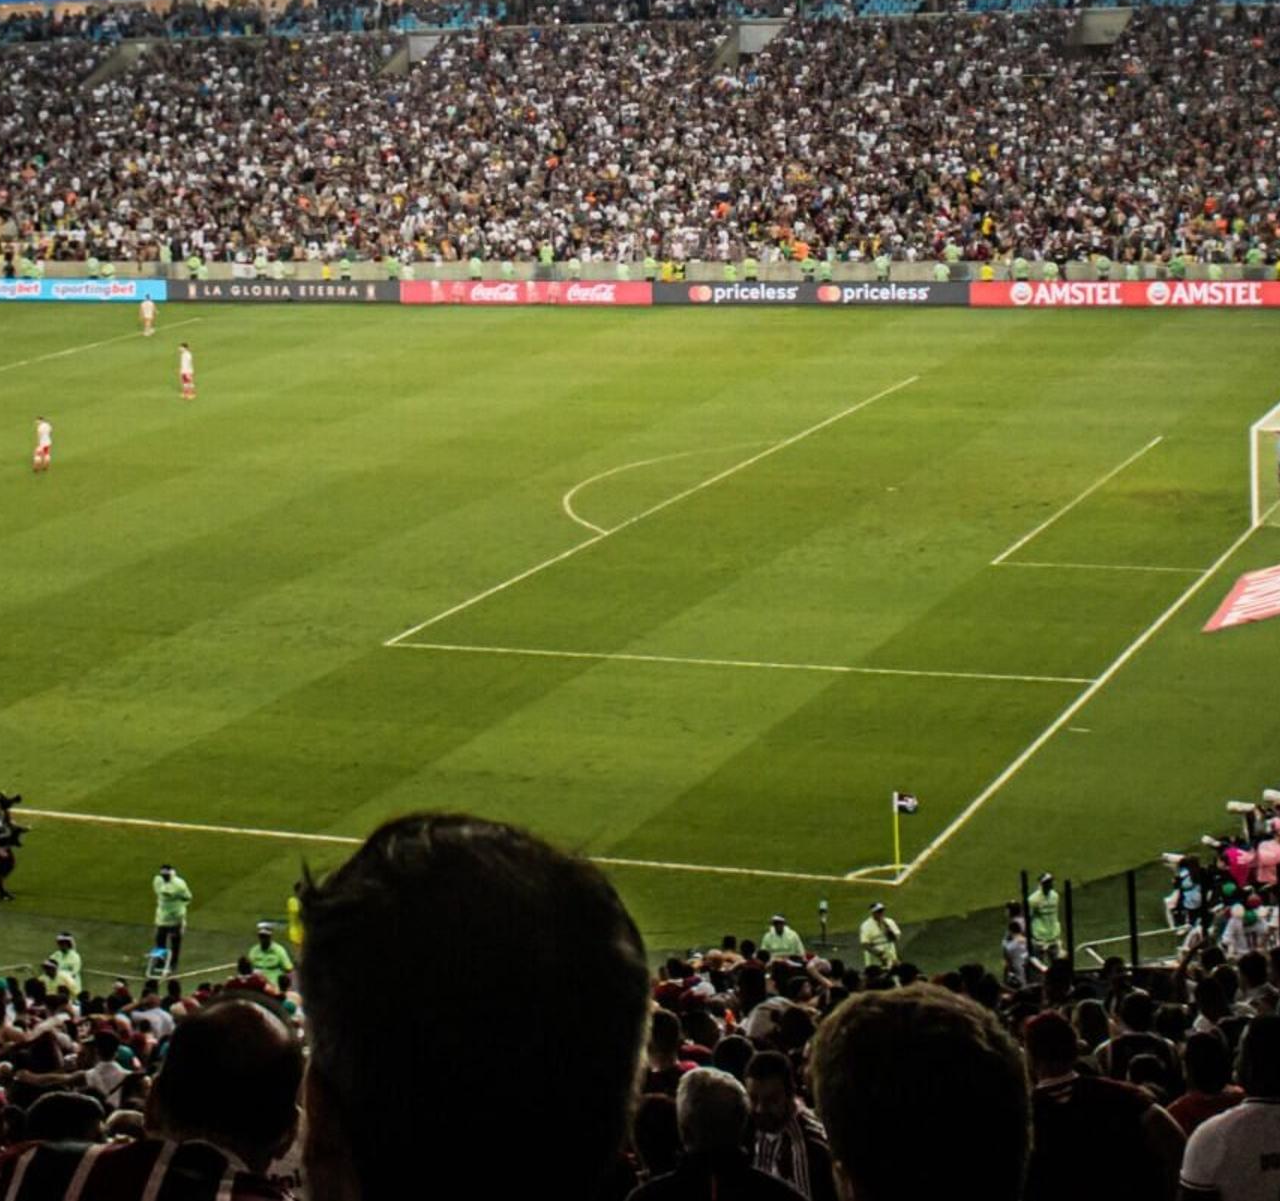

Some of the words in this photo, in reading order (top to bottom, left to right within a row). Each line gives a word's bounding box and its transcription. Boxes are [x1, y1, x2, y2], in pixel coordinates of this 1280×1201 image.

[52, 281, 135, 299] sportingbet
[204, 284, 222, 297] LA
[230, 284, 291, 297] GLORIA
[299, 284, 359, 297] ETERNA
[471, 283, 519, 302] Coca-Cola
[567, 283, 616, 302] Coca-Cola
[714, 284, 799, 303] priceless
[843, 284, 931, 303] priceless
[1033, 281, 1123, 304] AMSTEL
[1170, 281, 1262, 304] AMSTEL
